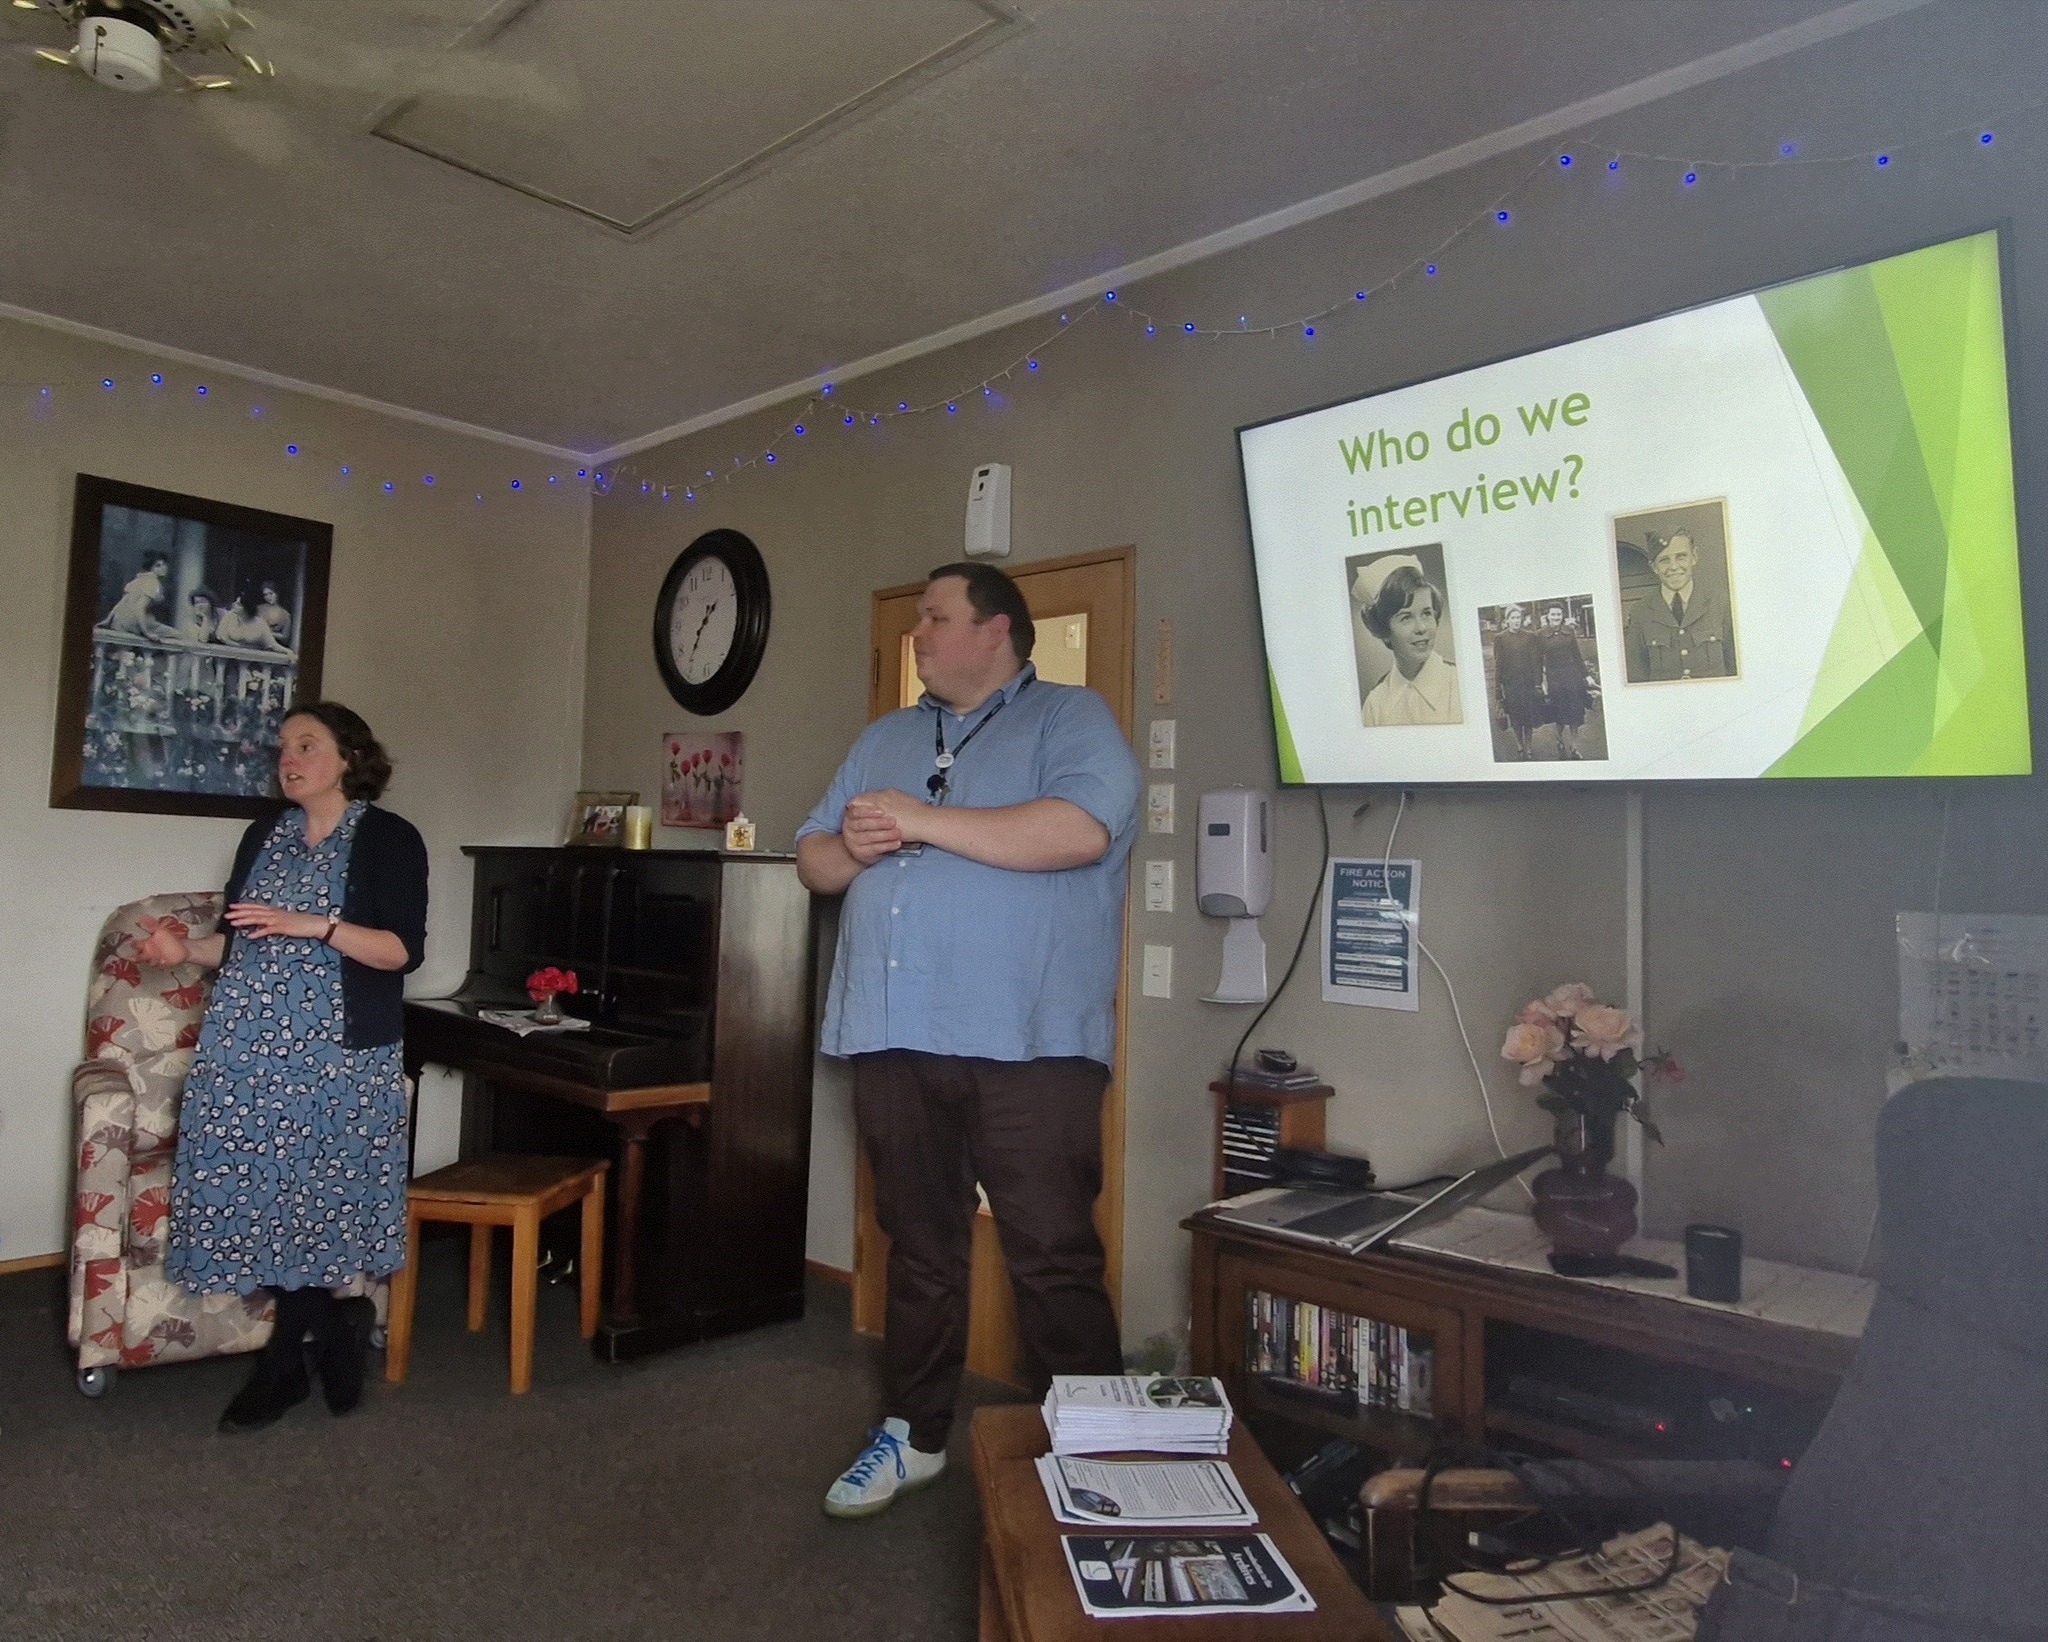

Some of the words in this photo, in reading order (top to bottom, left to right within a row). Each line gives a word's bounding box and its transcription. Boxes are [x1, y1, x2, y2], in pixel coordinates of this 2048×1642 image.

[1338, 428, 1429, 475] Who
[1446, 407, 1501, 452] do
[1516, 392, 1591, 436] we
[1346, 454, 1584, 538] interview?
[1340, 867, 1363, 877] FIRE
[1365, 869, 1406, 878] ACON
[1352, 879, 1389, 889] NOTIC
